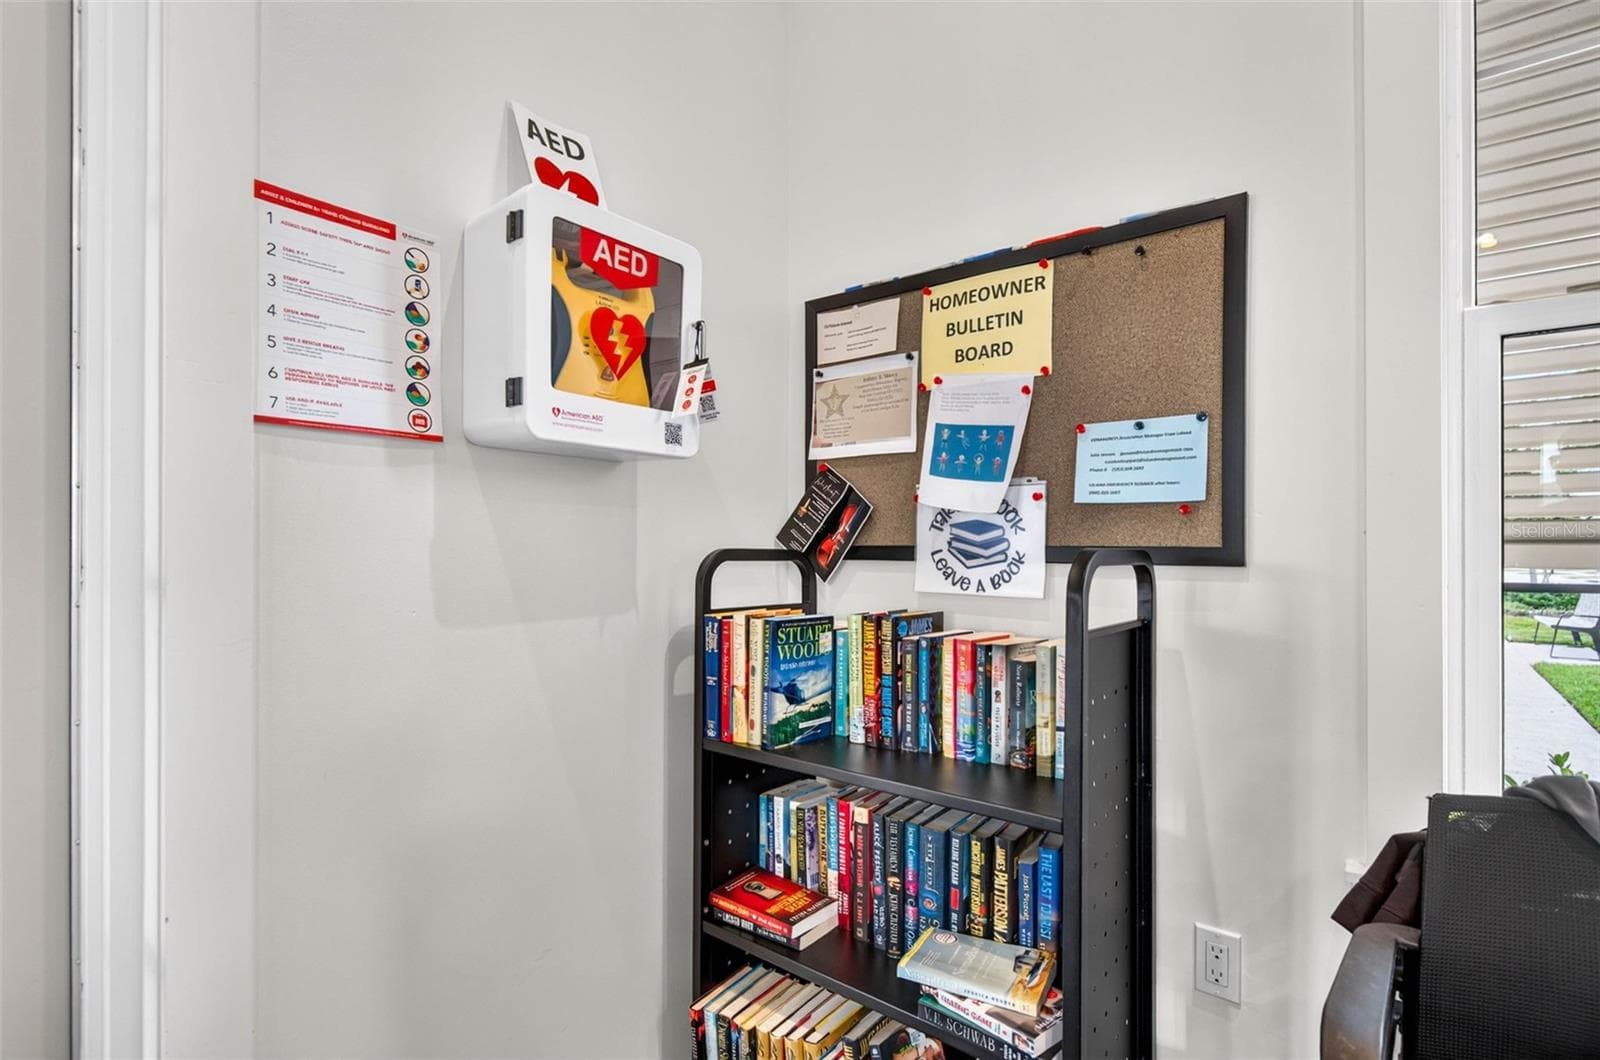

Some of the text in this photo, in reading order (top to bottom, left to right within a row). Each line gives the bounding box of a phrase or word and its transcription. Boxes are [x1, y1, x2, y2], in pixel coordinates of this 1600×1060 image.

[527, 118, 585, 161] AED
[267, 211, 273, 224] 1
[266, 242, 277, 257] 2
[593, 238, 648, 279] AED
[266, 273, 277, 288] 3
[928, 275, 1047, 313] HOMEOWNER
[266, 303, 277, 317] 4
[945, 309, 1024, 338] BULLETIN
[266, 335, 277, 349] 5
[954, 341, 1014, 363] BOARD
[267, 367, 279, 379] 6
[269, 396, 279, 409] 7
[976, 579, 986, 593] A
[864, 622, 875, 649] JAMES
[864, 650, 876, 697] PATTERSON
[873, 822, 884, 849] ALICE
[889, 836, 898, 873] TESTAMENT
[951, 838, 960, 861] KILLING
[1040, 853, 1053, 873] THE
[970, 876, 981, 914] PATTERSON
[994, 847, 1009, 933] JAMES PATTERSON
[1040, 875, 1053, 900] LAST
[889, 893, 899, 944] JOHN GRISHAM
[923, 1007, 997, 1052] V.E. SCHWAB
